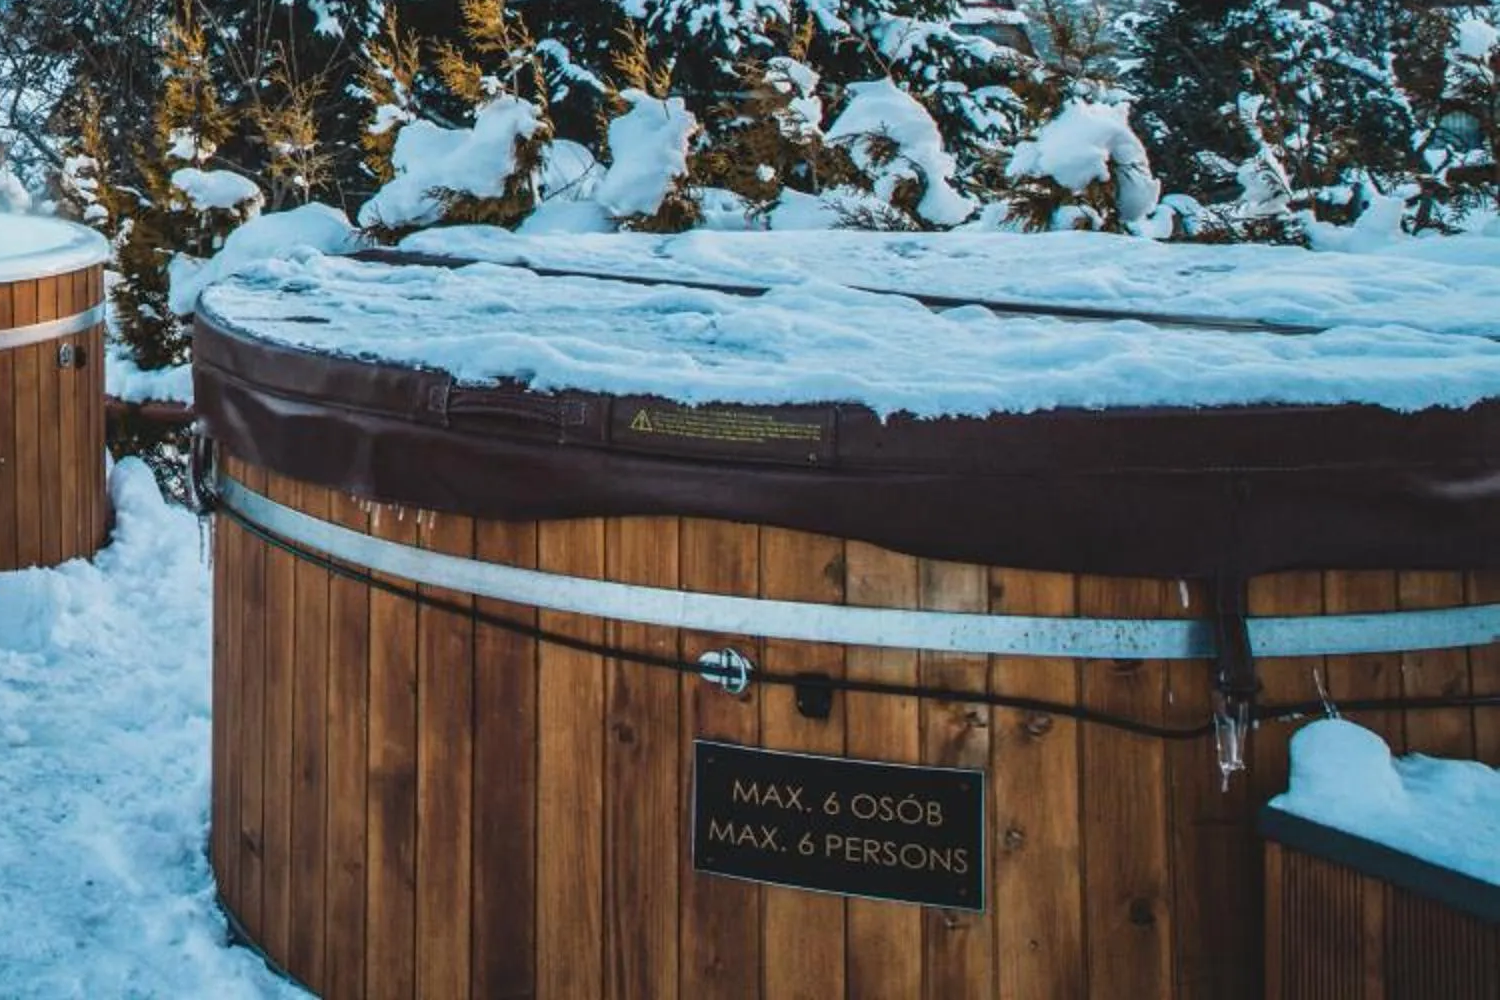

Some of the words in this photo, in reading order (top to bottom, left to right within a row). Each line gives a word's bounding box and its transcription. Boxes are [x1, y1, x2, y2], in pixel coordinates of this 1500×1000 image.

[732, 779, 812, 813] MAX.
[822, 791, 840, 815] 6
[850, 793, 943, 827] OSÓB
[708, 818, 787, 852] MAX.
[798, 832, 815, 855] 6
[825, 834, 968, 874] PERSONS
